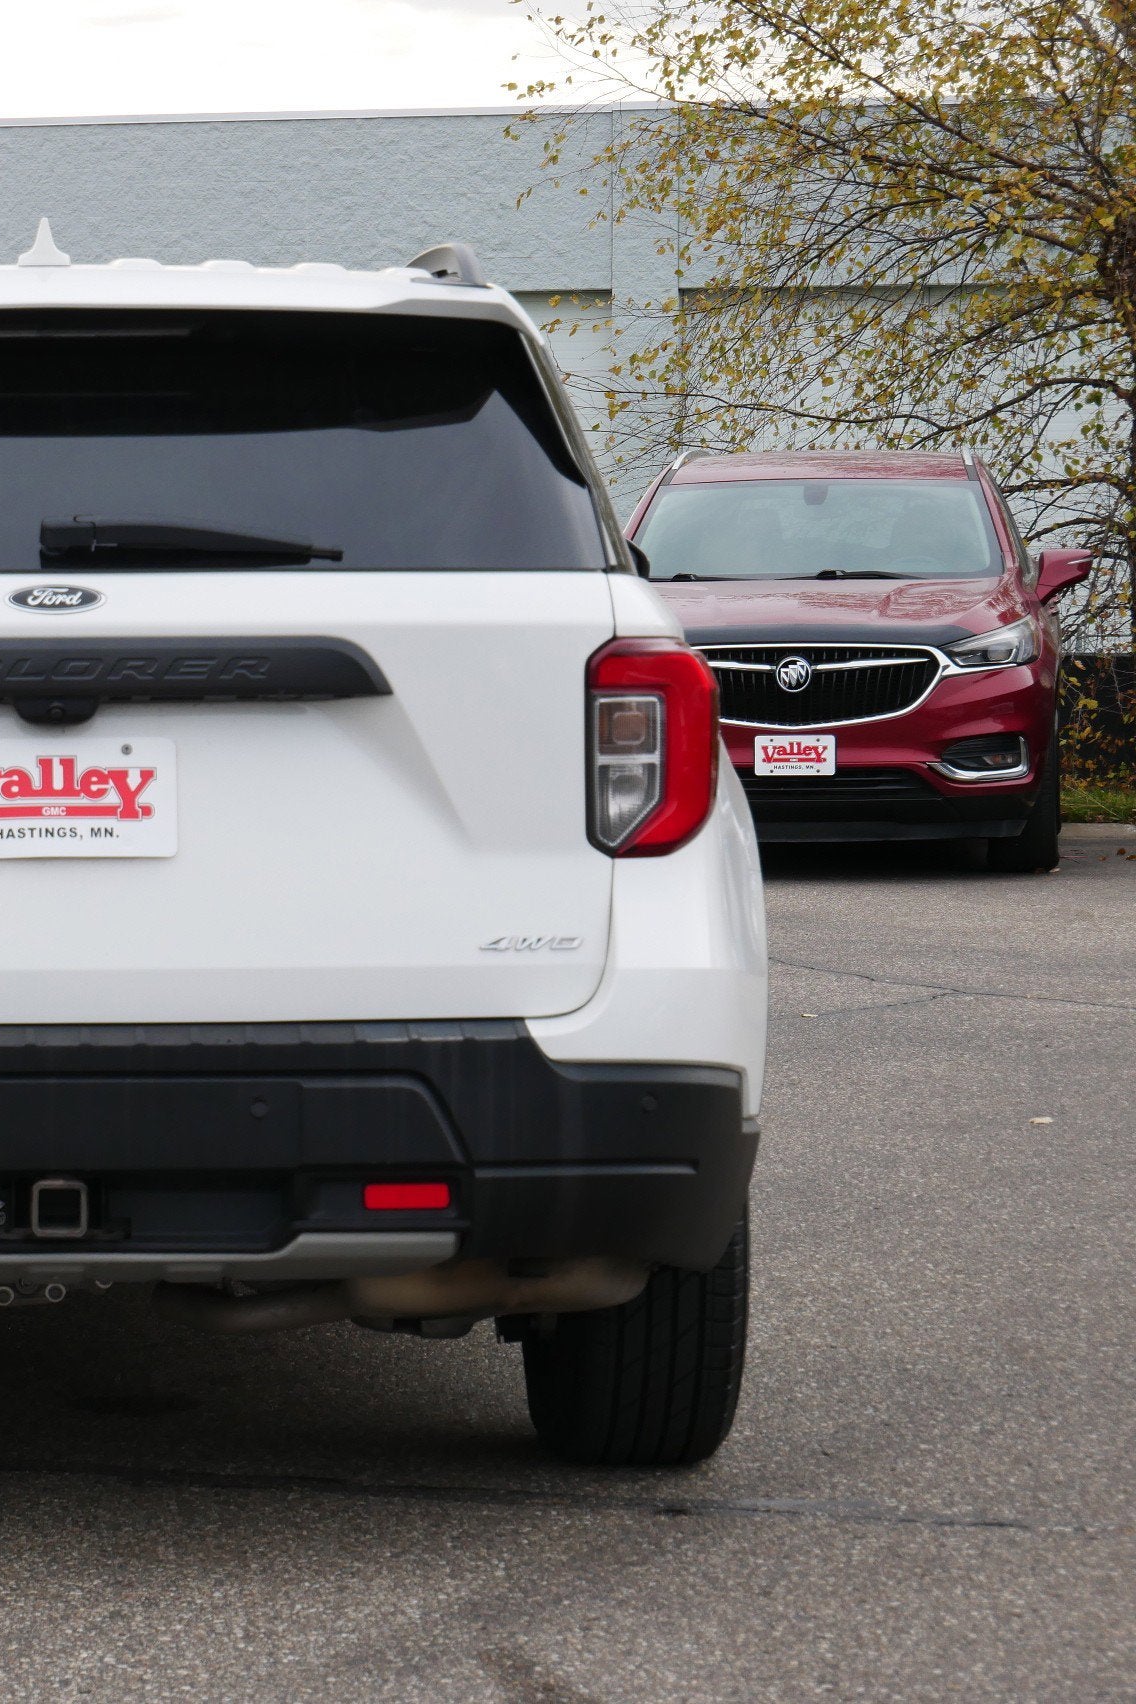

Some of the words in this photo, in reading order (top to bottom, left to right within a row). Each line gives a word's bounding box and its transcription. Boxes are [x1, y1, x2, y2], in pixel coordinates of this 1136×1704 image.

[26, 585, 83, 606] Ford
[41, 806, 67, 816] GMC
[90, 826, 120, 839] MN.
[479, 935, 585, 952] 4WD
